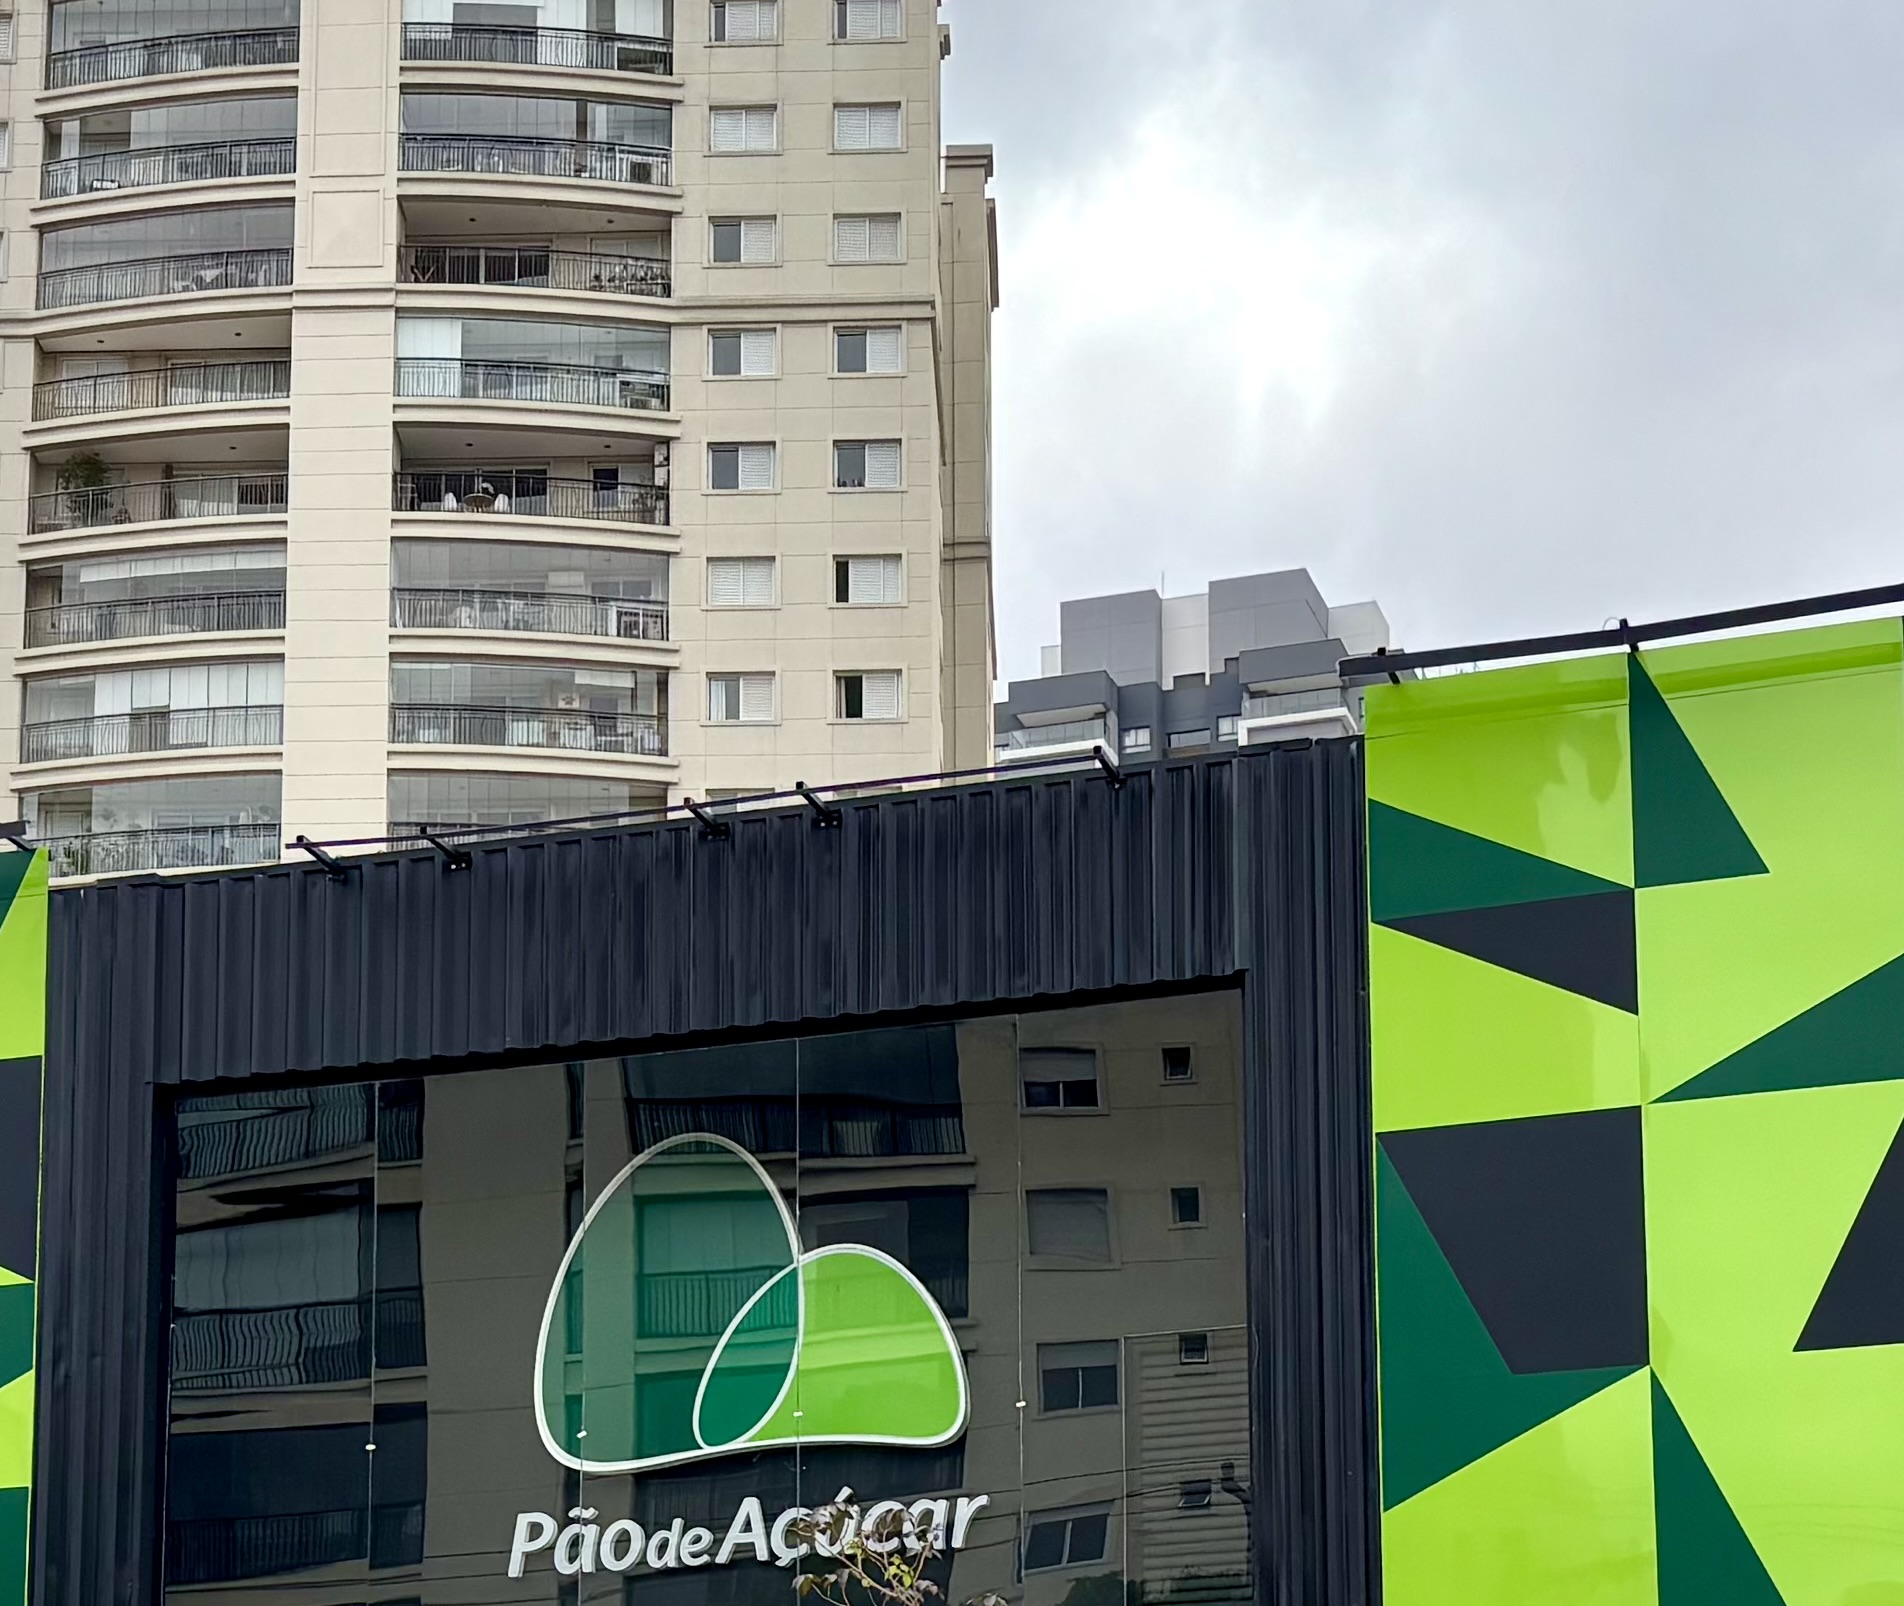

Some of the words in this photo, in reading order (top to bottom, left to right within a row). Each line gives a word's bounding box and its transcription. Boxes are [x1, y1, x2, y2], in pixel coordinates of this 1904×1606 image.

[507, 1506, 646, 1578] Pão
[646, 1516, 715, 1570] de
[715, 1485, 991, 1568] Açúcar
